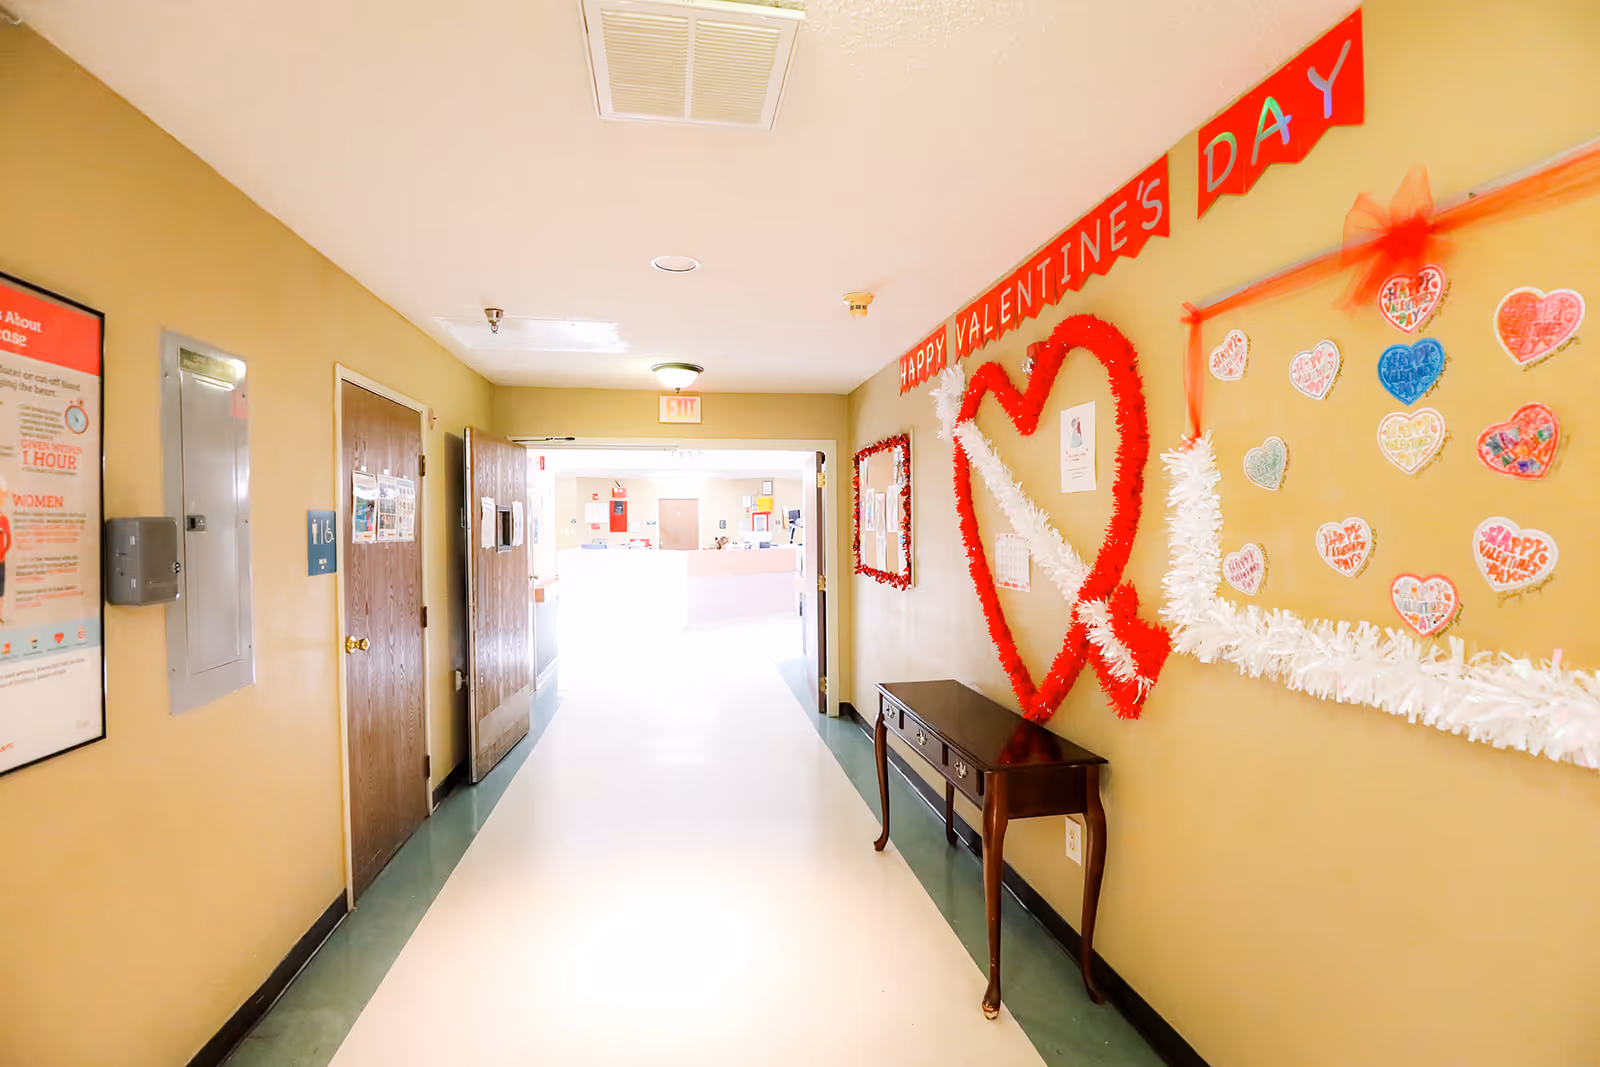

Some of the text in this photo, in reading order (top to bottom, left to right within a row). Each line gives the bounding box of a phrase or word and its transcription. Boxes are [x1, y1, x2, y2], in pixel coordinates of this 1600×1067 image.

[900, 39, 1351, 386] HAPPY VALENTINE'S DAY
[4, 310, 43, 334] About
[667, 398, 697, 420] EXIT
[33, 450, 78, 471] HOUR
[12, 493, 64, 508] WOMEN
[1483, 525, 1548, 561] HAPPY
